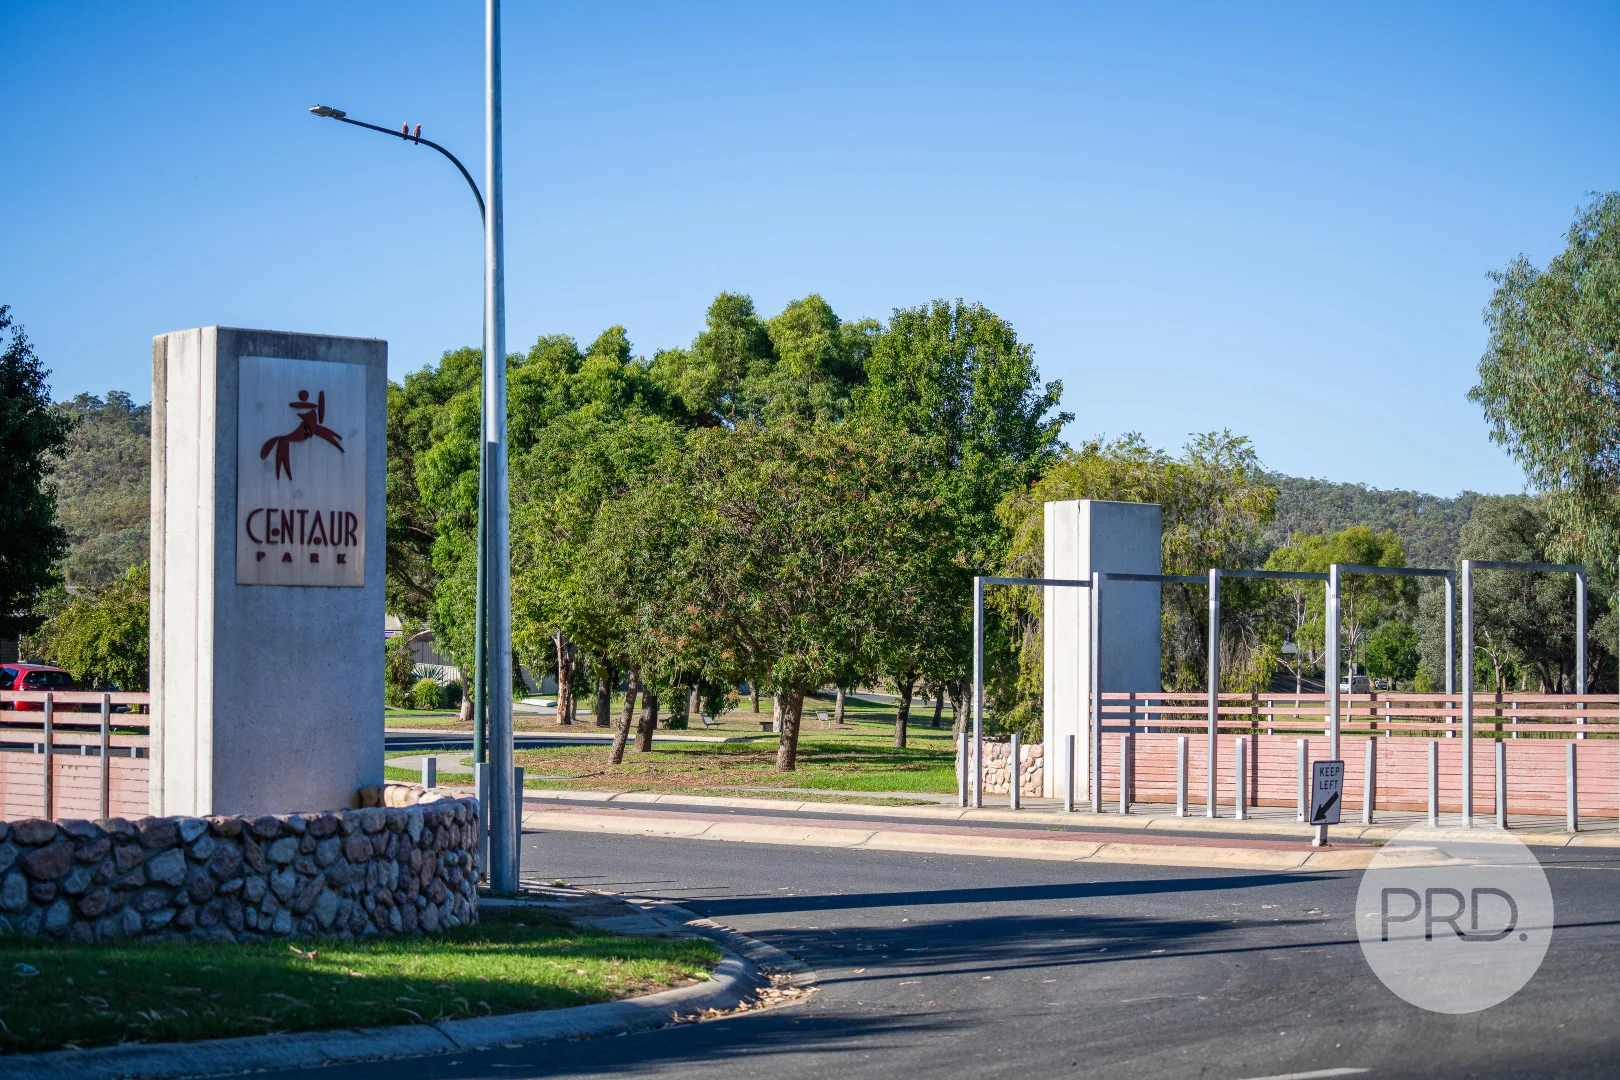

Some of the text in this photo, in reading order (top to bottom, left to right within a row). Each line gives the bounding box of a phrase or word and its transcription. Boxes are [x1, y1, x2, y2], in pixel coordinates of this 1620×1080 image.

[246, 508, 358, 547] CENTAUR
[256, 551, 347, 565] PARK
[1319, 766, 1340, 777] KEEP
[1319, 779, 1339, 790] LEFT
